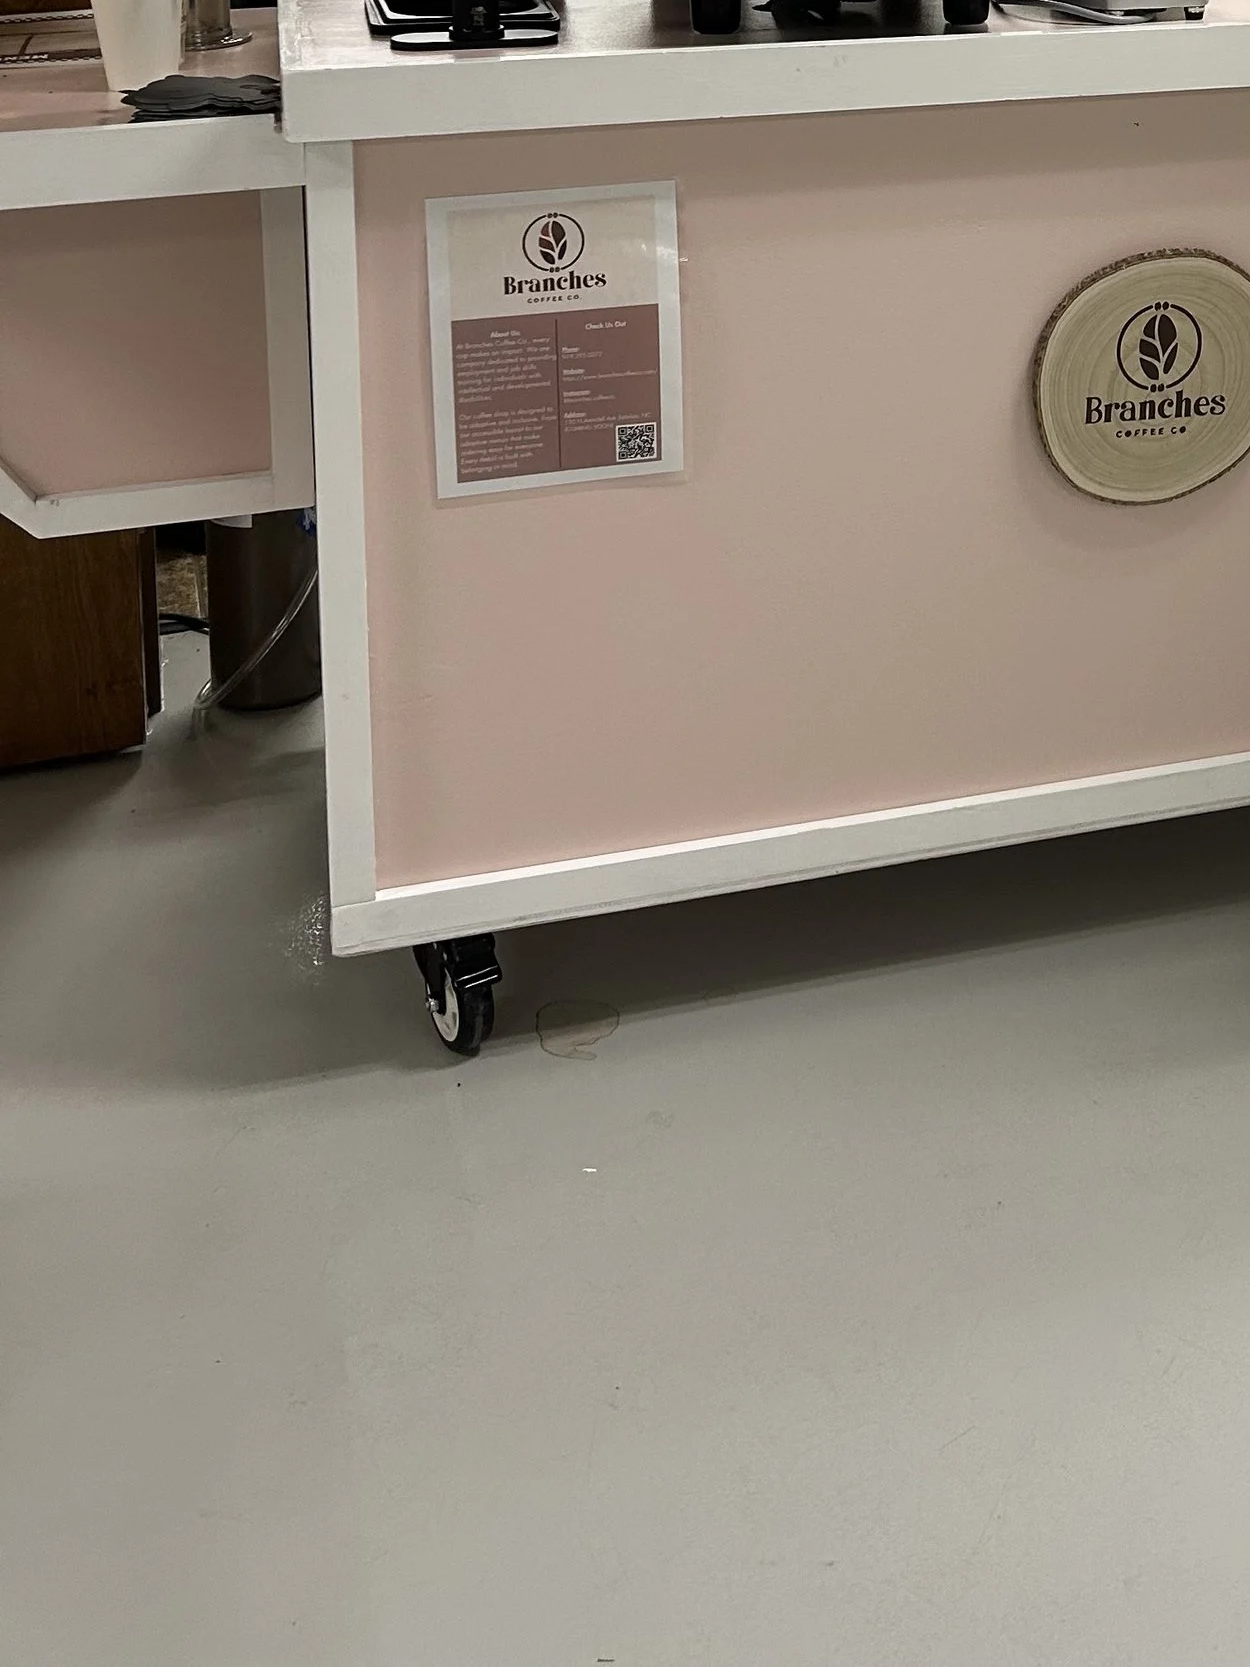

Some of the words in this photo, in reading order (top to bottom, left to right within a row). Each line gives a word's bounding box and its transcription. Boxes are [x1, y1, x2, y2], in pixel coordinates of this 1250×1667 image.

[503, 270, 607, 295] Branches
[527, 295, 562, 304] COFFEE
[585, 322, 603, 330] Check
[1085, 389, 1226, 425] Branches
[1116, 427, 1164, 438] COFFEE
